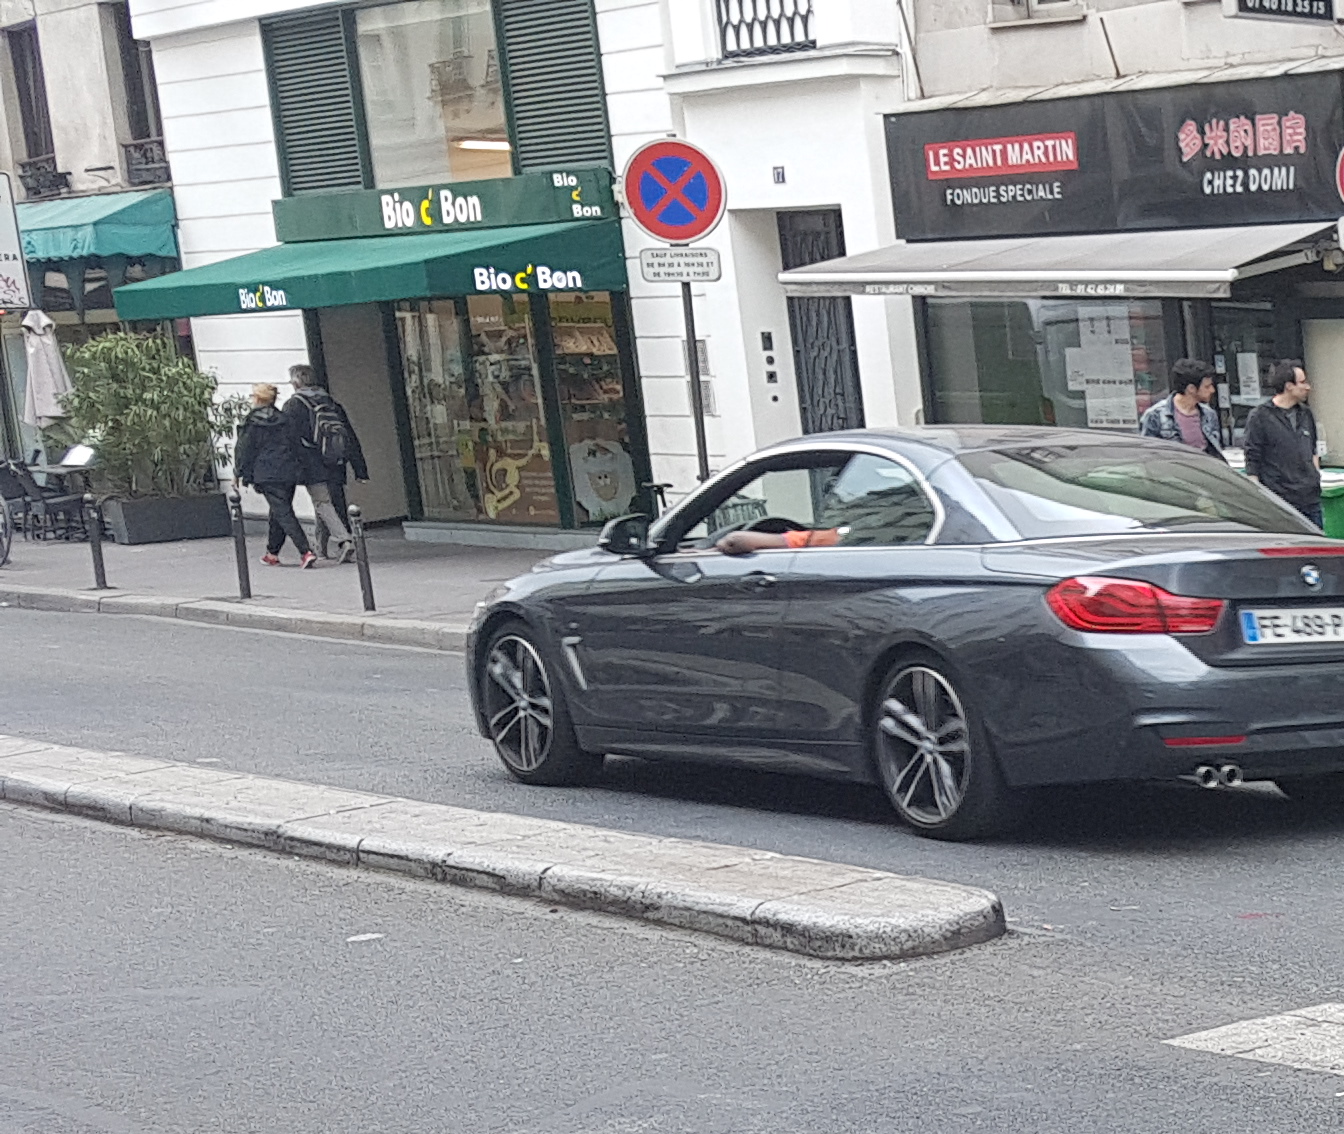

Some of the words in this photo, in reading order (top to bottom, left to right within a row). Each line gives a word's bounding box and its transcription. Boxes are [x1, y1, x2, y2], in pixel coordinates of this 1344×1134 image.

[928, 147, 951, 171] LE
[953, 144, 1003, 170] SAINT
[1006, 138, 1075, 165] MARTIN
[552, 172, 578, 187] Bio
[1202, 169, 1244, 195] CHEZ
[1248, 166, 1295, 192] DOMI
[945, 186, 998, 205] FONDUE
[999, 182, 1063, 203] SPECIALE
[381, 192, 415, 229] Bio
[440, 189, 482, 224] Bon
[572, 203, 602, 217] Bon
[474, 265, 512, 291] Bio
[536, 265, 583, 290] Bon
[238, 288, 256, 309] Bio
[263, 286, 287, 307] Bon
